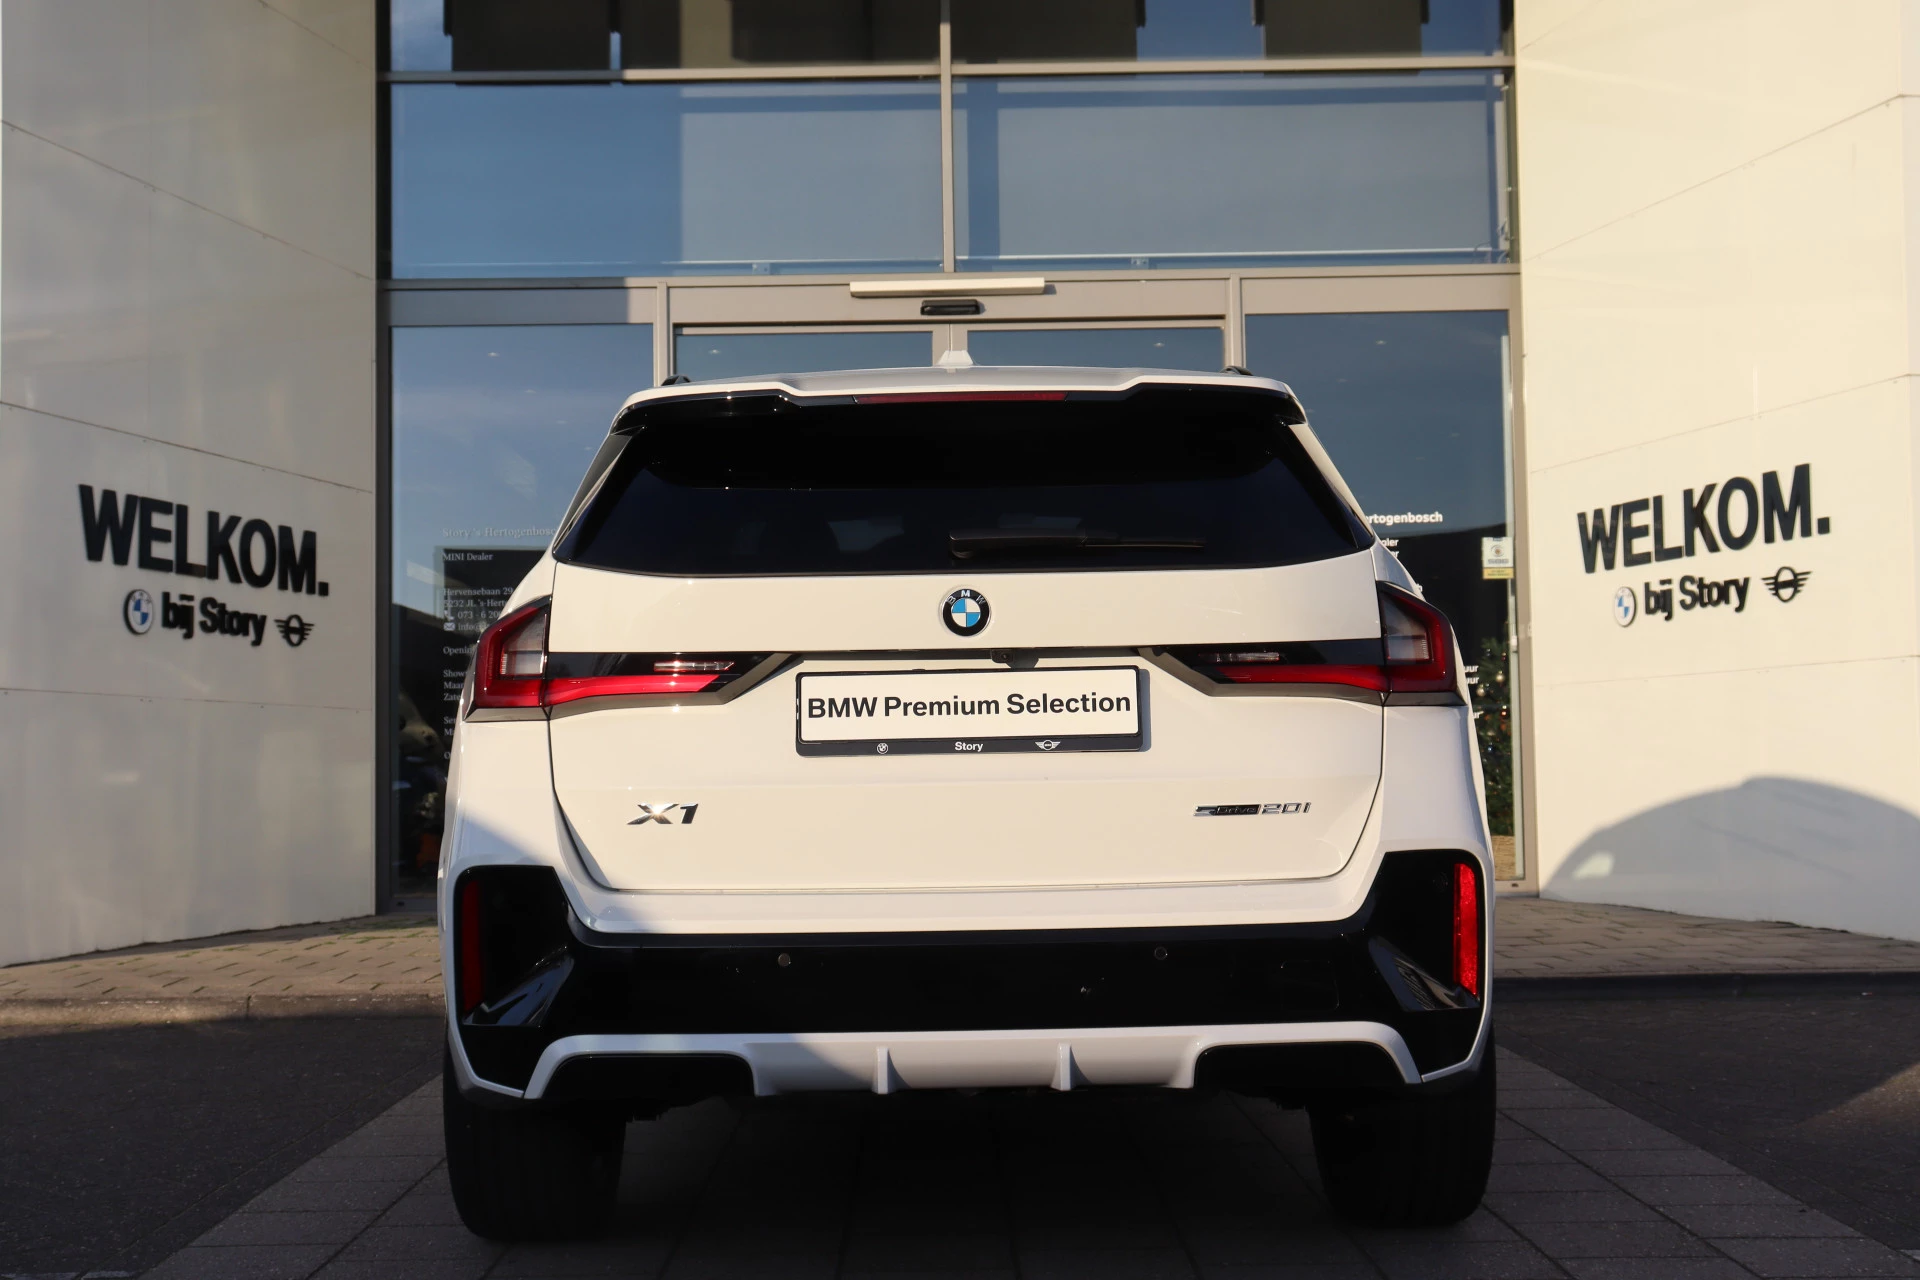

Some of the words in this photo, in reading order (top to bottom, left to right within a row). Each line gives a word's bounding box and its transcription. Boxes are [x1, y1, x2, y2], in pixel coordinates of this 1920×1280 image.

[442, 527, 468, 538] Story
[1577, 463, 1831, 574] WELKOM.
[78, 483, 330, 597] WELKOM.
[1644, 578, 1674, 621] bij
[1679, 575, 1750, 613] Story
[161, 591, 195, 640] bij
[199, 597, 267, 647] Story
[808, 696, 878, 719] BMW
[884, 695, 1000, 717] Premium
[1006, 691, 1131, 715] Selection
[954, 741, 984, 752] Story
[626, 803, 699, 825] X1
